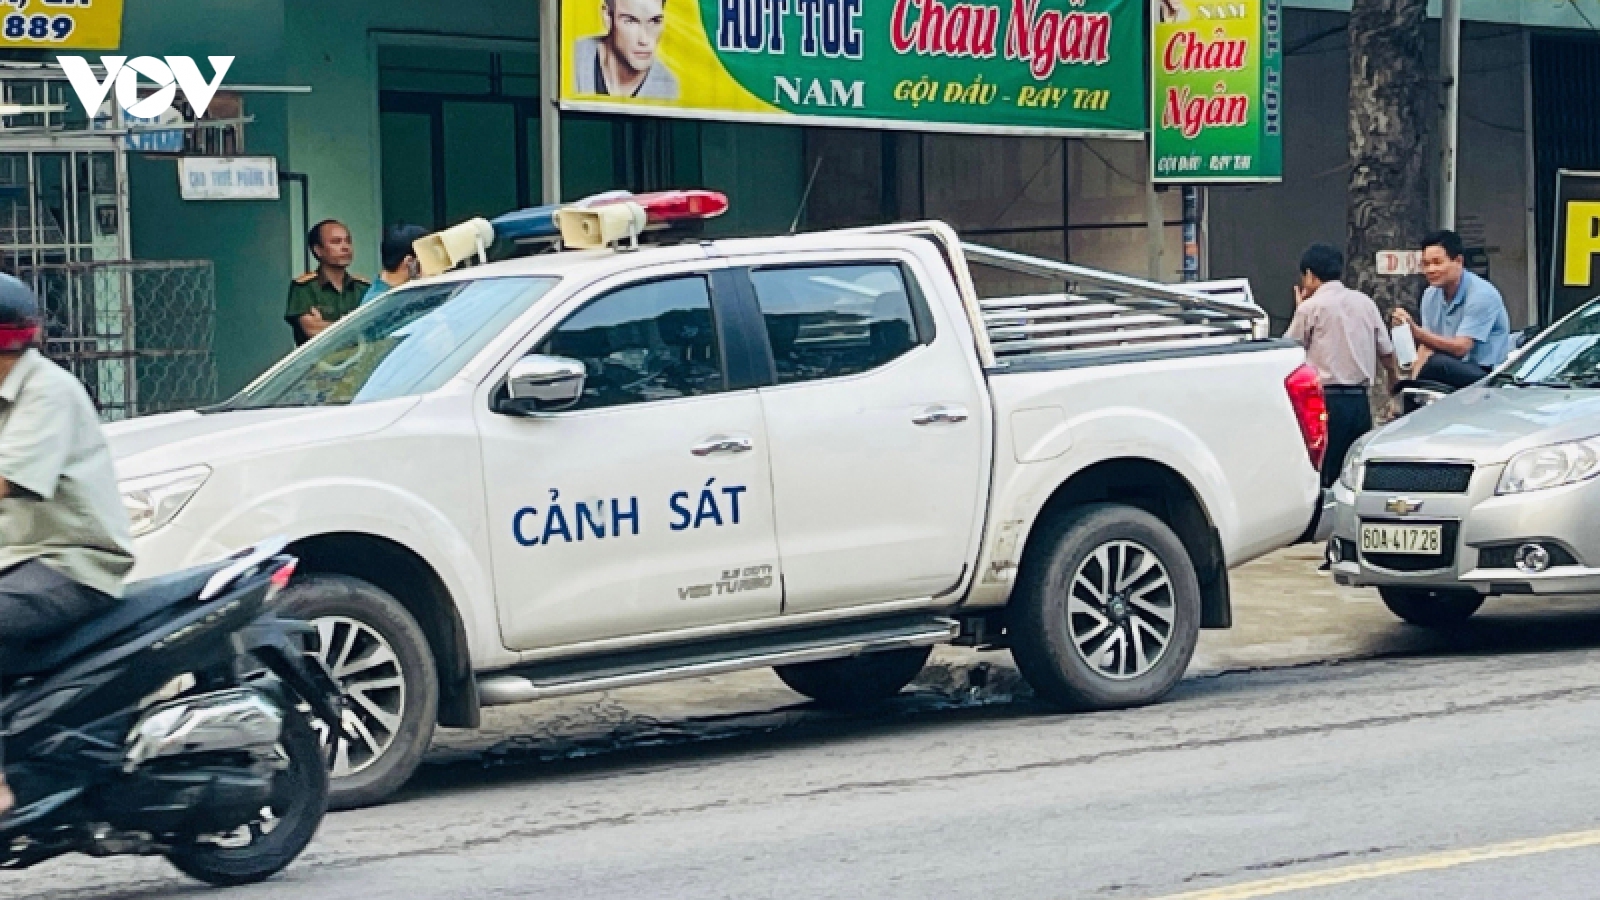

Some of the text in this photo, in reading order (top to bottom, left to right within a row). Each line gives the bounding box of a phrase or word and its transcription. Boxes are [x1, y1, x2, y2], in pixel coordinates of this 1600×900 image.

[2, 12, 75, 42] 889
[1164, 27, 1248, 73] Châu
[774, 76, 865, 108] NAM
[1073, 88, 1110, 110] TAI
[1162, 80, 1249, 140] Ngân
[512, 476, 747, 547] CẢNH SÁT
